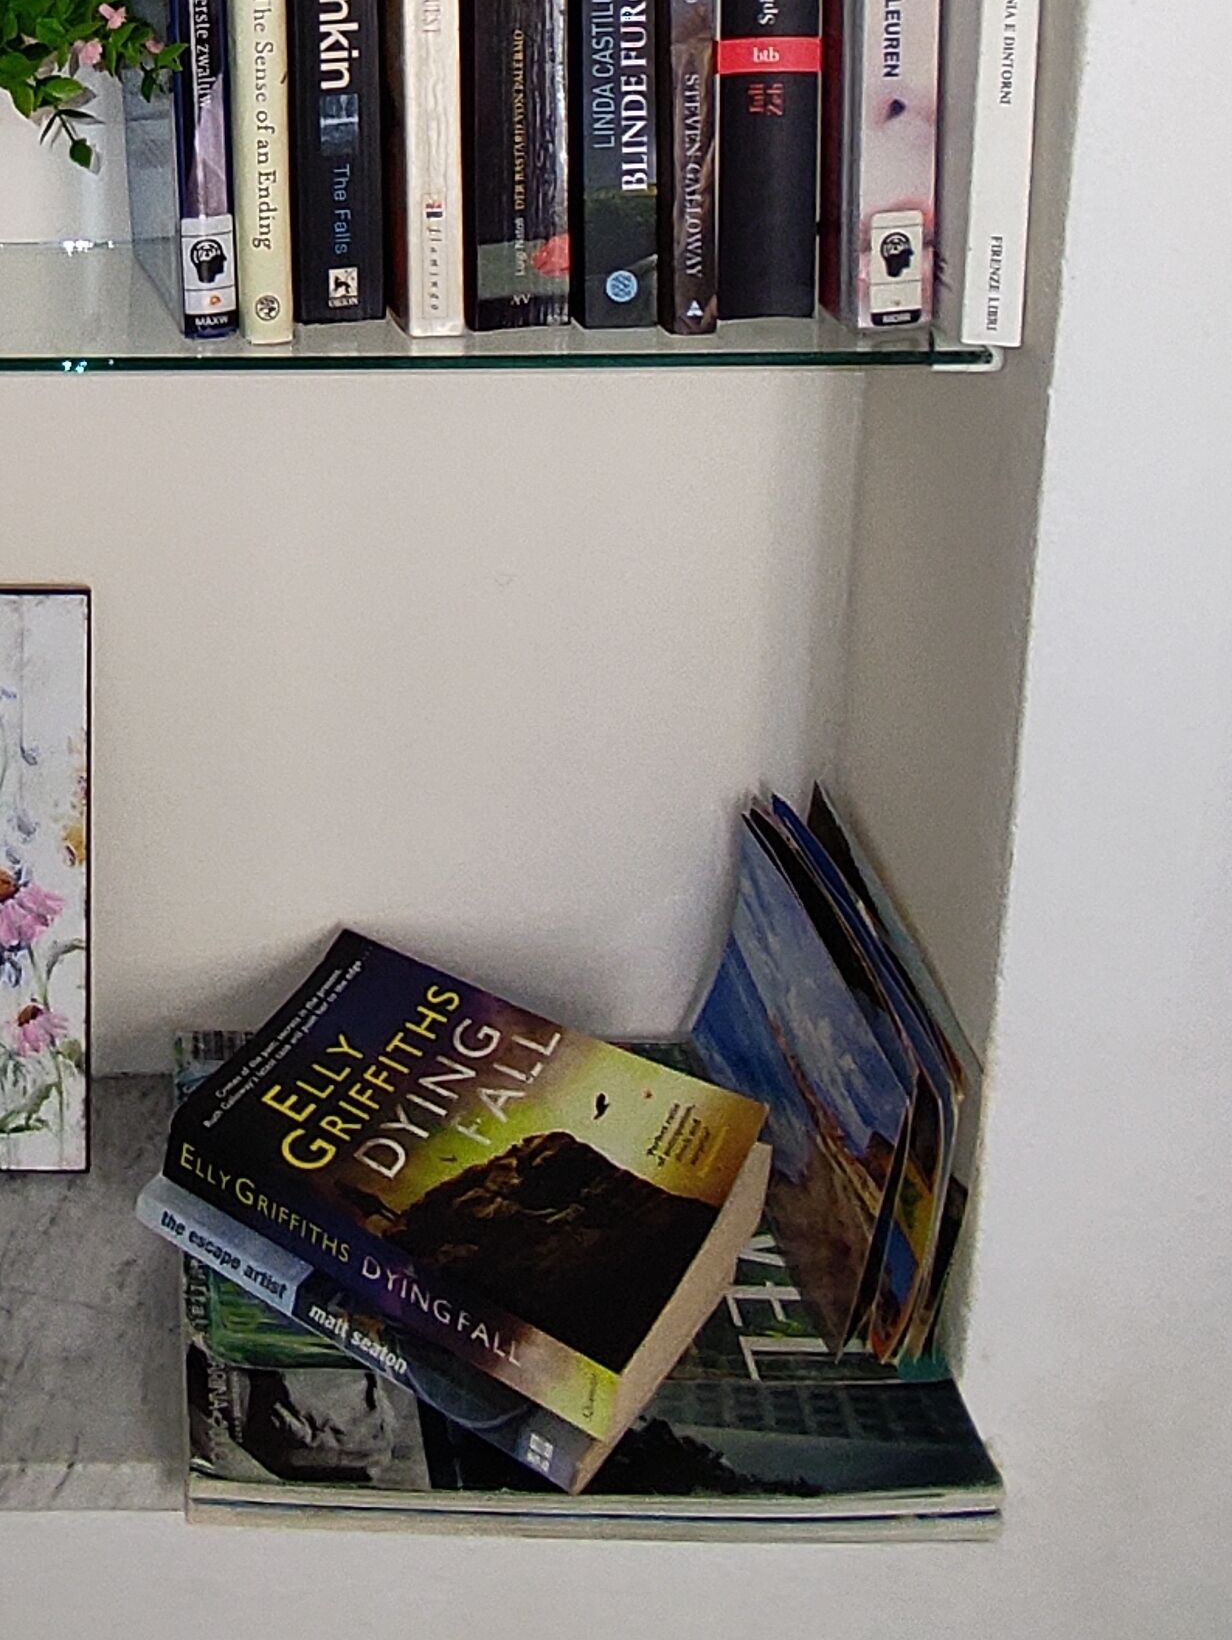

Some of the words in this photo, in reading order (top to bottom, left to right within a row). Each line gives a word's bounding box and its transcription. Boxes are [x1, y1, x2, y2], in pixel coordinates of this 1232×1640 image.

[1004, 23, 1016, 32] E
[254, 41, 274, 103] Sense
[514, 29, 525, 89] PALERMO
[1000, 36, 1016, 105] DINTORNI
[256, 110, 277, 136] of
[514, 93, 526, 121] VON
[593, 85, 614, 148] LINDA
[684, 74, 703, 156] STEVEN
[748, 82, 765, 113] Juli
[765, 82, 785, 115] Zeh
[256, 139, 274, 165] an
[514, 124, 526, 180] BASTARD
[621, 76, 648, 192] BLINDE
[253, 171, 279, 249] Ending
[333, 163, 351, 203] The
[515, 186, 526, 209] DER
[332, 210, 353, 255] Falls
[684, 162, 704, 278] GALLOWAY
[515, 251, 525, 276] Luigi
[988, 236, 1003, 292] FIRENZE
[986, 296, 1000, 331] LIBRI
[262, 1033, 364, 1123] ELLY
[281, 984, 460, 1170] GRIFFITHS
[354, 1018, 501, 1181] DYING
[456, 1030, 562, 1145] FALL
[180, 1143, 232, 1189] ELLY
[235, 1177, 350, 1263] GRIFFITHS
[160, 1210, 185, 1236] the
[188, 1228, 241, 1270] escape
[243, 1263, 288, 1299] artist
[308, 1304, 348, 1341] matt
[351, 1329, 408, 1374] seaton
[361, 1255, 452, 1324] DYING
[457, 1309, 522, 1366] FALL
